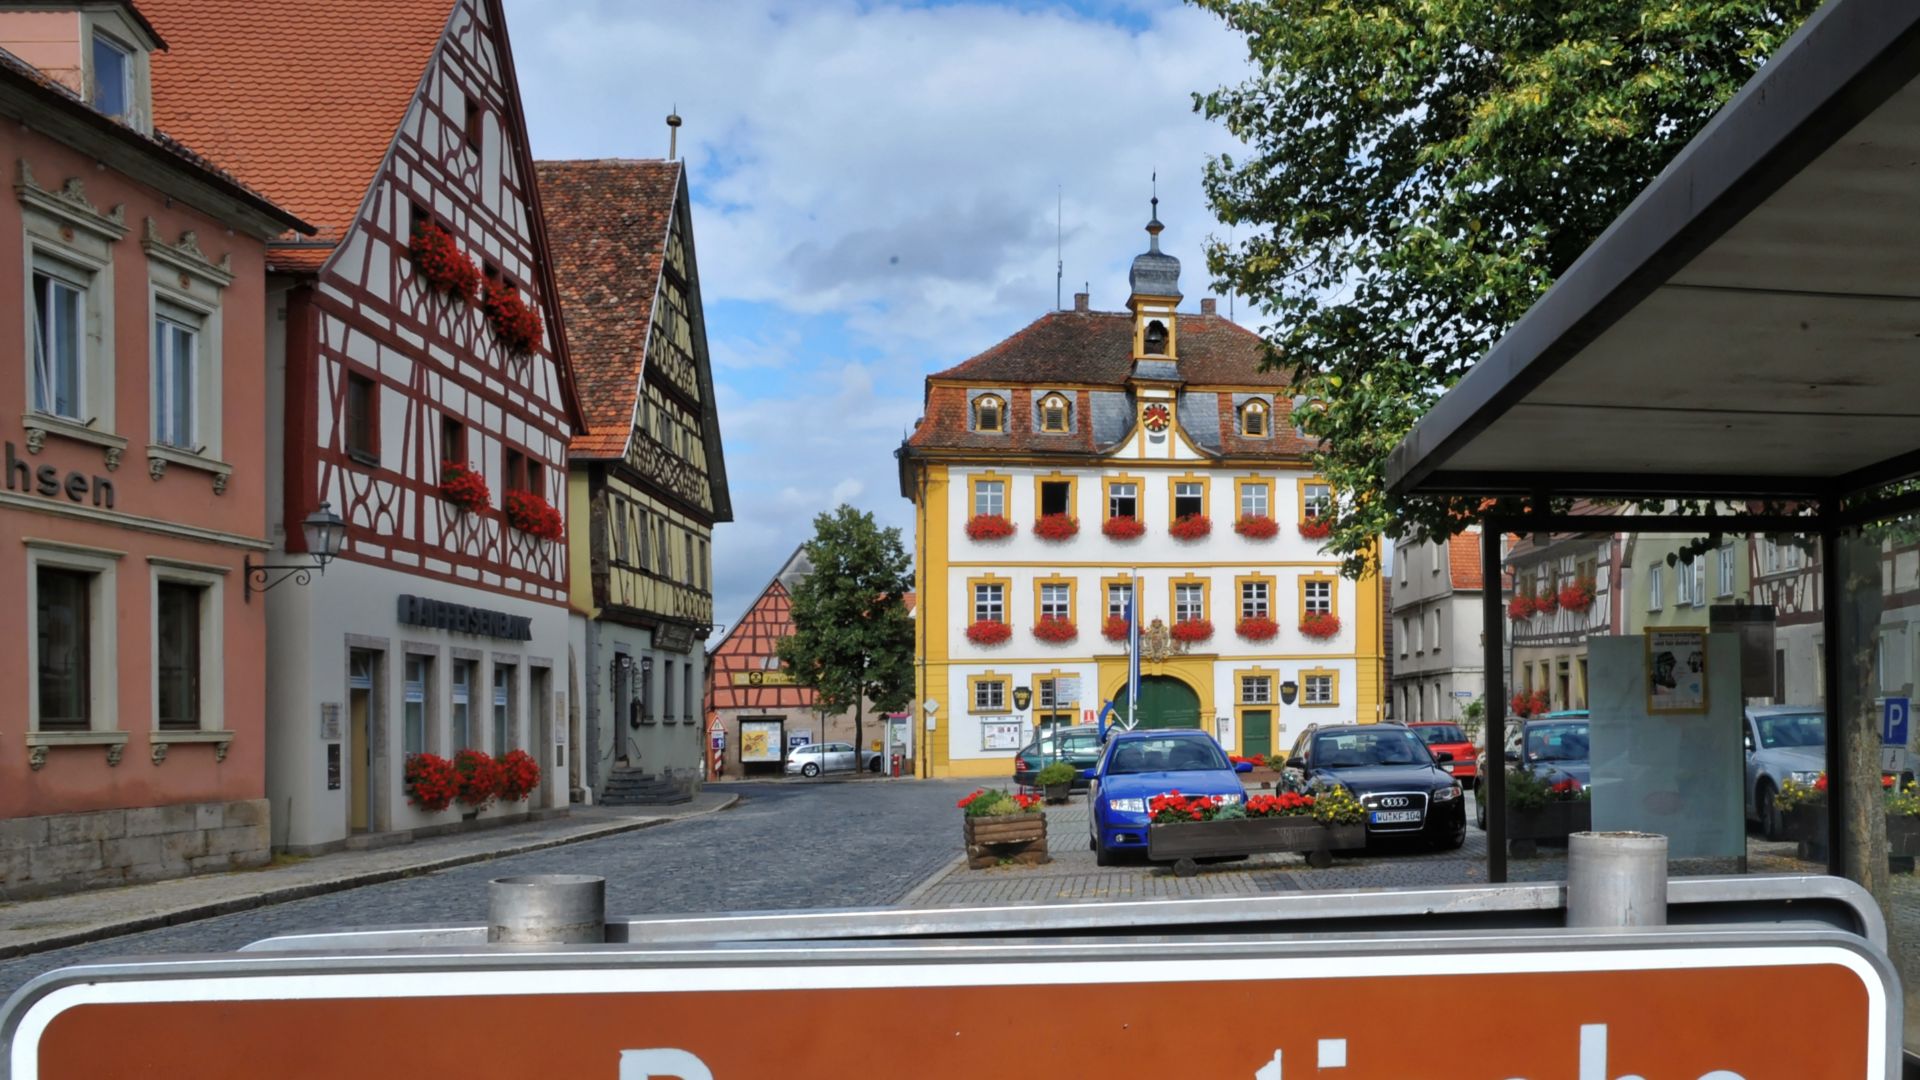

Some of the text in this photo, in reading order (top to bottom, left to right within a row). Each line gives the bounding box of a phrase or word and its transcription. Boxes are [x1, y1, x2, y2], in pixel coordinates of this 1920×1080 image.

[5, 441, 114, 509] hsen
[398, 594, 534, 641] RAIFFEISENBANK
[1888, 703, 1903, 739] P
